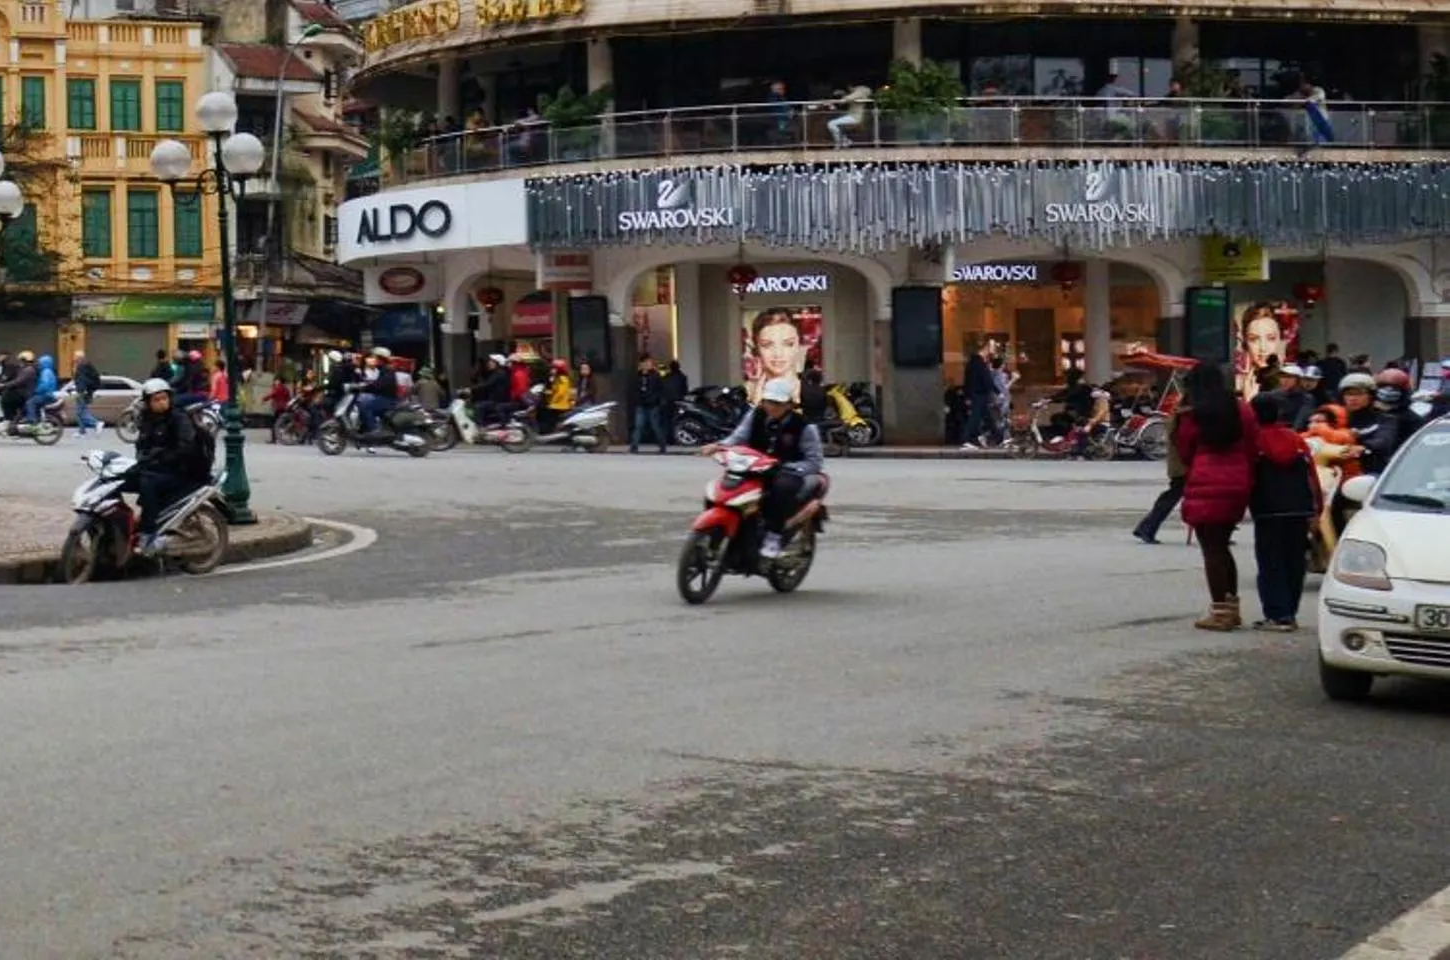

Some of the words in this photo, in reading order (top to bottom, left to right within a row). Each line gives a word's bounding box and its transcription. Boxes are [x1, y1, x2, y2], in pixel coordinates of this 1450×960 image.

[356, 199, 452, 245] ALDO
[617, 207, 734, 231] SWAROVSKI
[1045, 202, 1155, 223] SWAROVSKI
[953, 264, 1037, 281] SWAROVSKI
